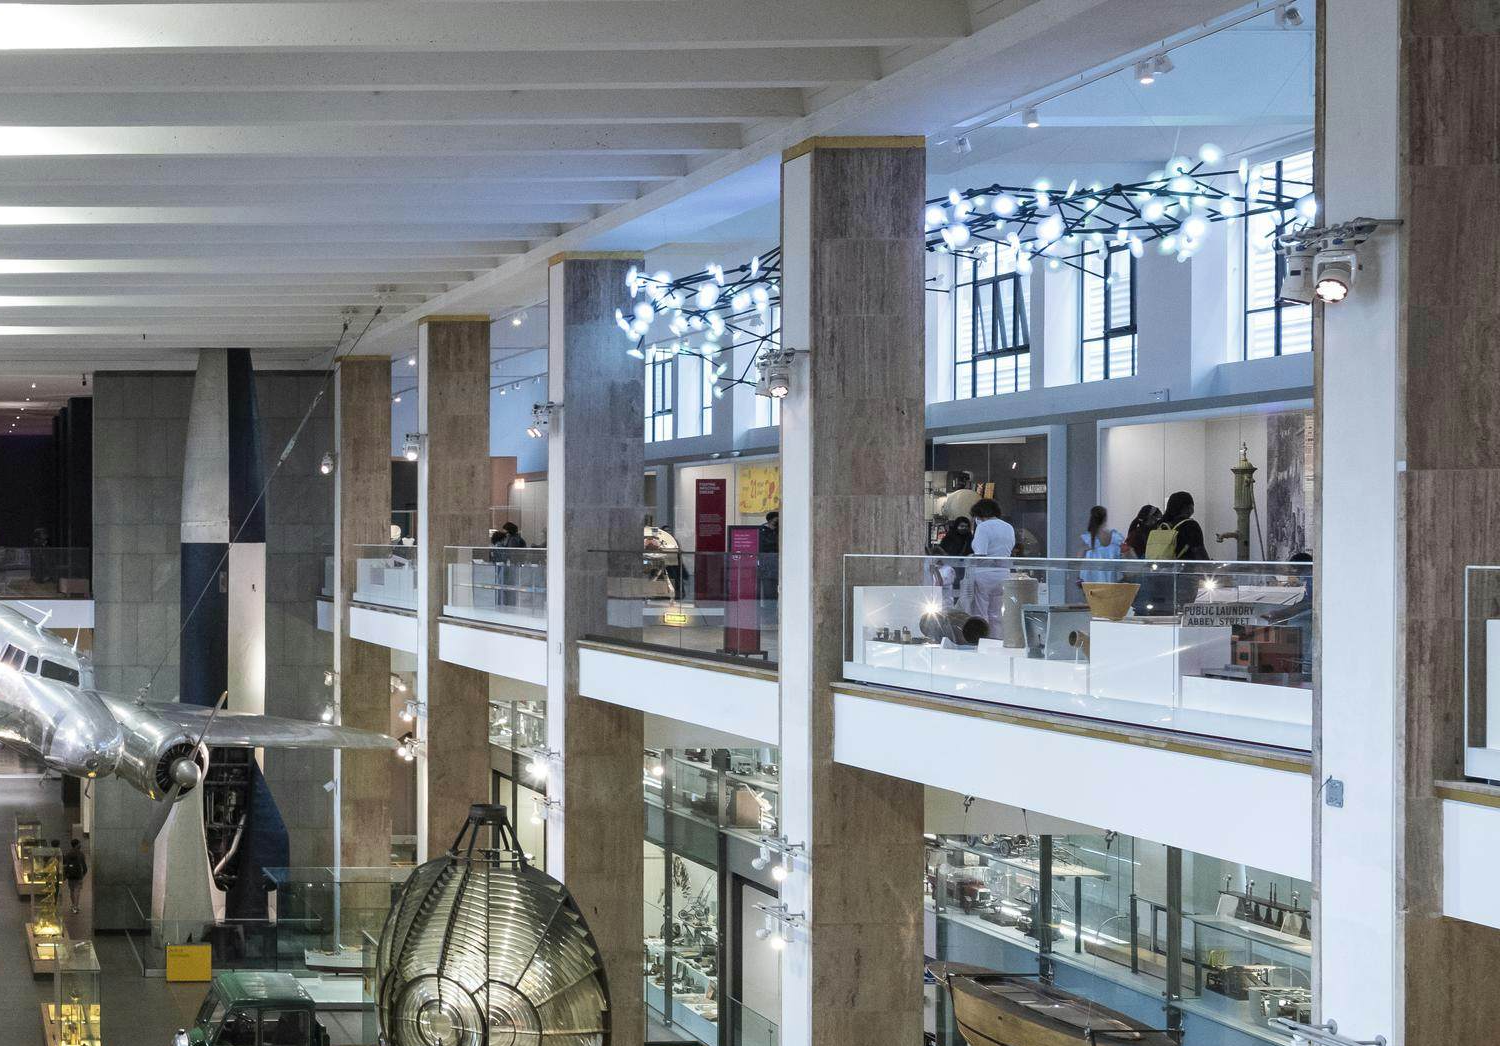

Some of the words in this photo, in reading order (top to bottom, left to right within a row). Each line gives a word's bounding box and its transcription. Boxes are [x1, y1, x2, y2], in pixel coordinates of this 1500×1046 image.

[1184, 606, 1214, 616] PUBLIC
[1215, 606, 1254, 615] LAUNDRY
[1187, 617, 1215, 626] ABBEY
[1219, 617, 1250, 626] STREET
